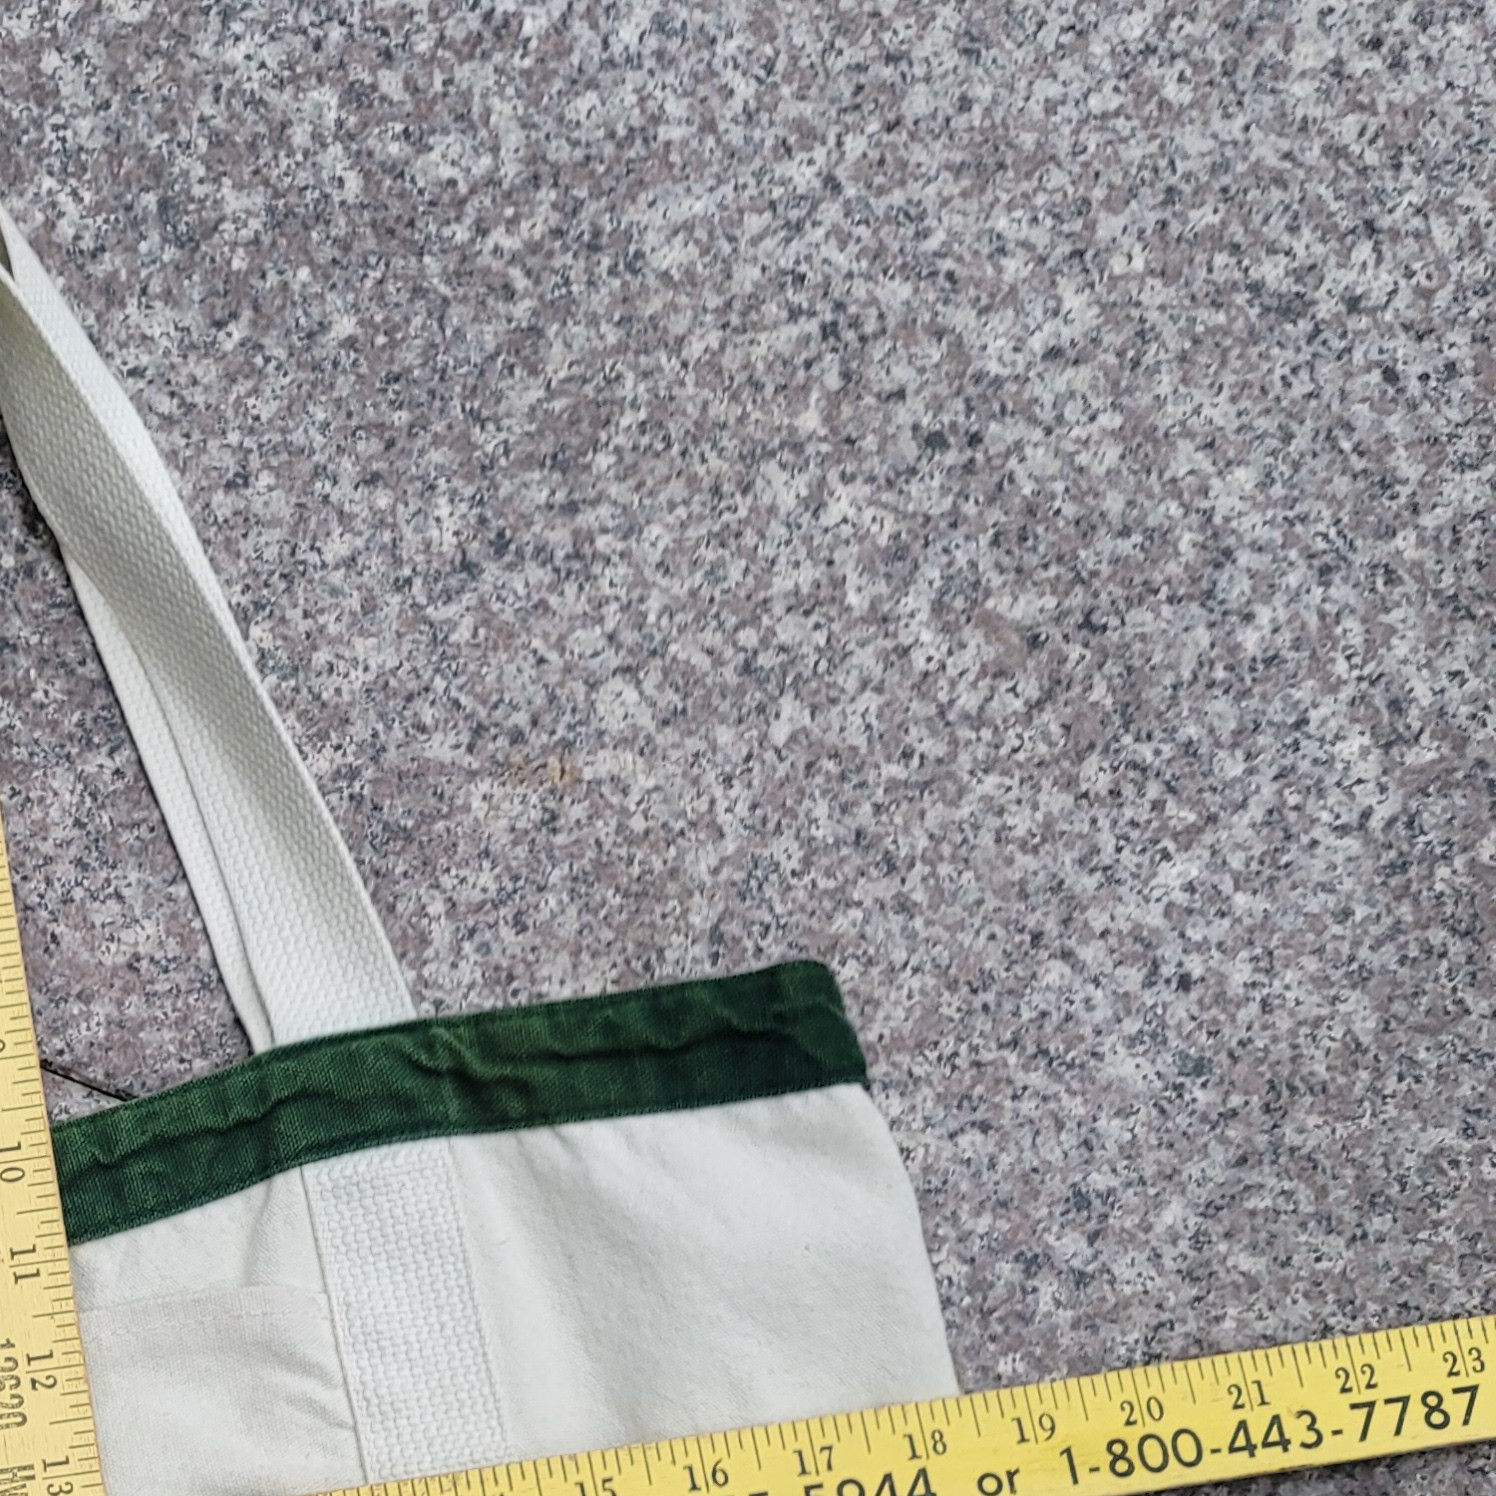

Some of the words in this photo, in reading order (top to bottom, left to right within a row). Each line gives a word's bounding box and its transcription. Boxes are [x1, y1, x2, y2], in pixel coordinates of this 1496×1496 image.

[8, 1243, 41, 1285] 11
[25, 1349, 58, 1391] 12
[684, 1459, 729, 1492] 16
[793, 1444, 833, 1476] 17
[903, 1428, 947, 1461] 18
[1011, 1411, 1056, 1444] 19
[1119, 1395, 1164, 1427] 20
[1226, 1379, 1270, 1410] 21
[1334, 1362, 1378, 1394] 22
[1441, 1346, 1485, 1378] 23
[976, 1467, 1020, 1496] or
[1059, 1384, 1477, 1482] 1-800-443-7787
[41, 1454, 74, 1496] 13
